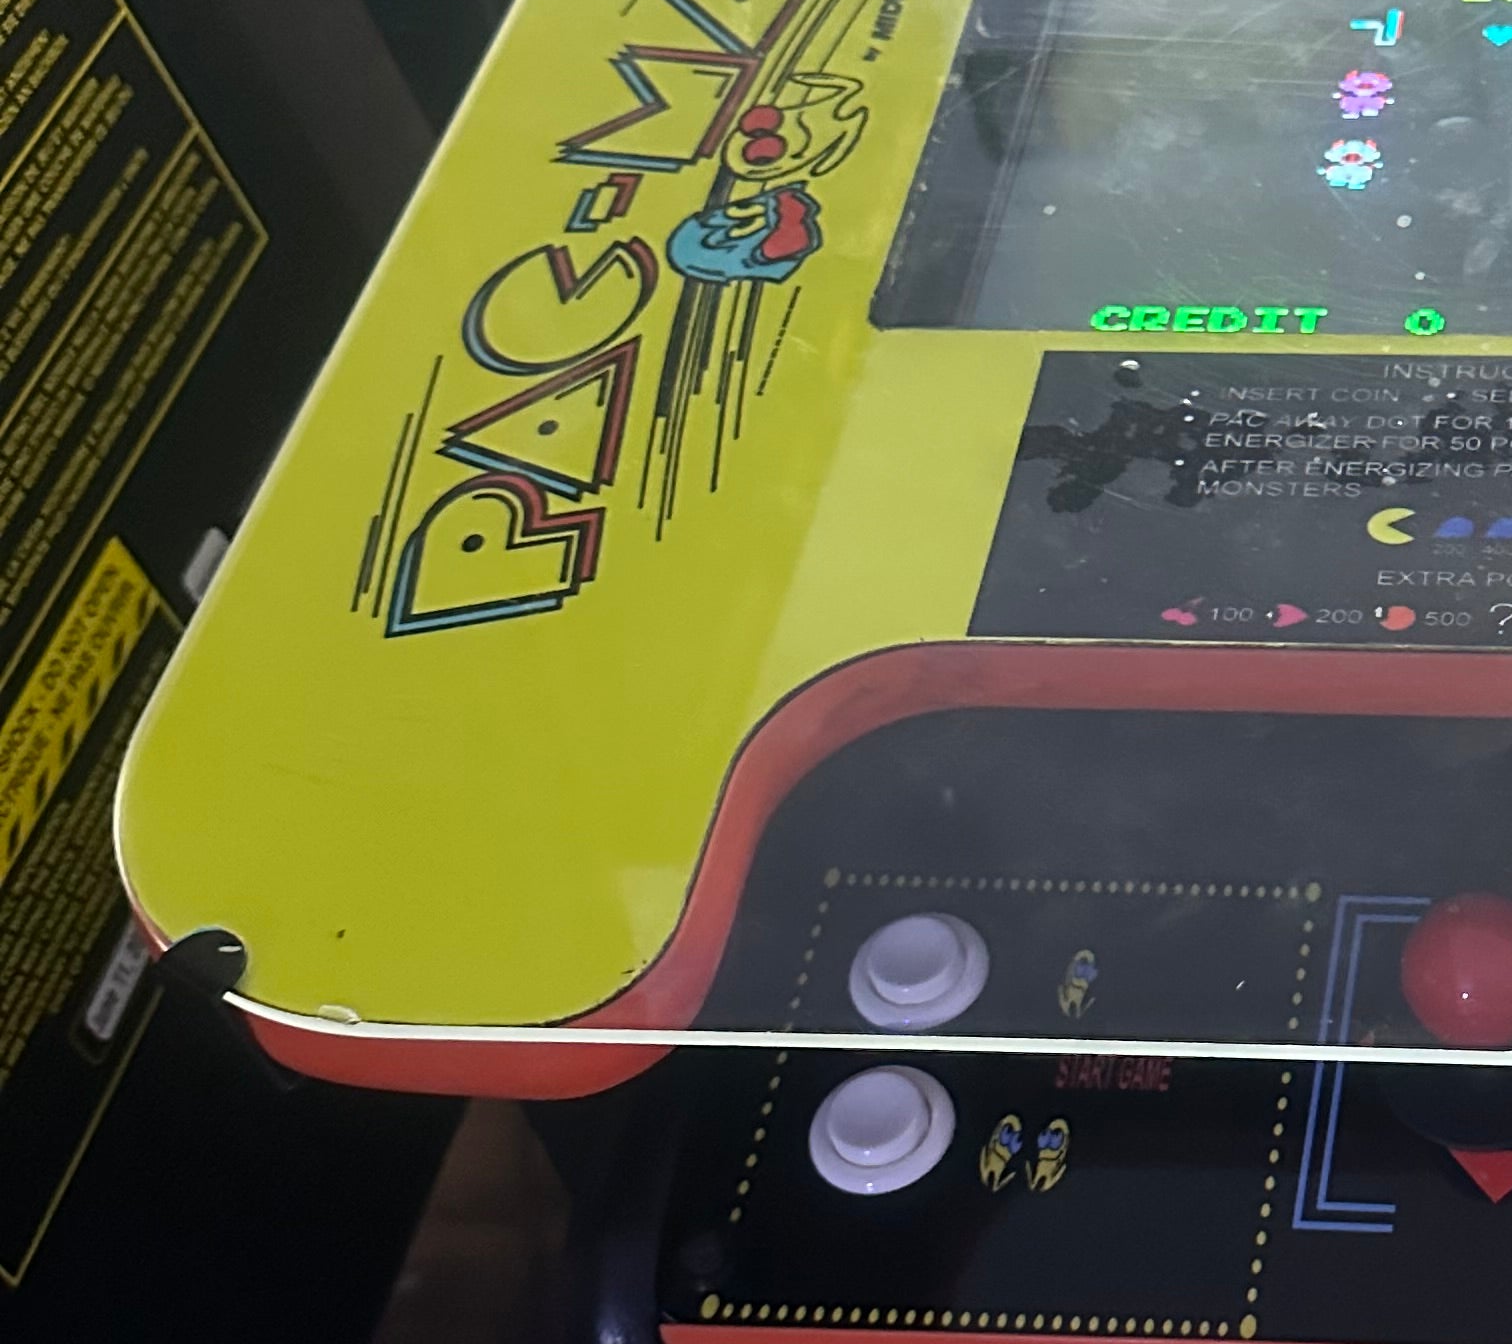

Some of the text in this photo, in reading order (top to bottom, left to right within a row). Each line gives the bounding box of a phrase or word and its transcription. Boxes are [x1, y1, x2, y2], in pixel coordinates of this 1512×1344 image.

[1089, 304, 1328, 335] CREDIT
[1219, 386, 1320, 402] INSERT
[1330, 386, 1400, 403] COIN
[1208, 410, 1267, 428] PAC
[1366, 414, 1426, 430] DOT
[1433, 415, 1493, 431] FOR
[1204, 433, 1375, 450] ENERGIZER
[1381, 435, 1441, 451] FOR
[1449, 436, 1482, 451] 50
[1199, 459, 1297, 476] AFTER
[1304, 460, 1486, 478] ENERGIZING
[1196, 479, 1363, 498] MONSTERS
[1376, 569, 1477, 587] EXTRA
[1209, 607, 1255, 623] 100
[1314, 608, 1365, 625] 200
[1423, 611, 1474, 627] 500
